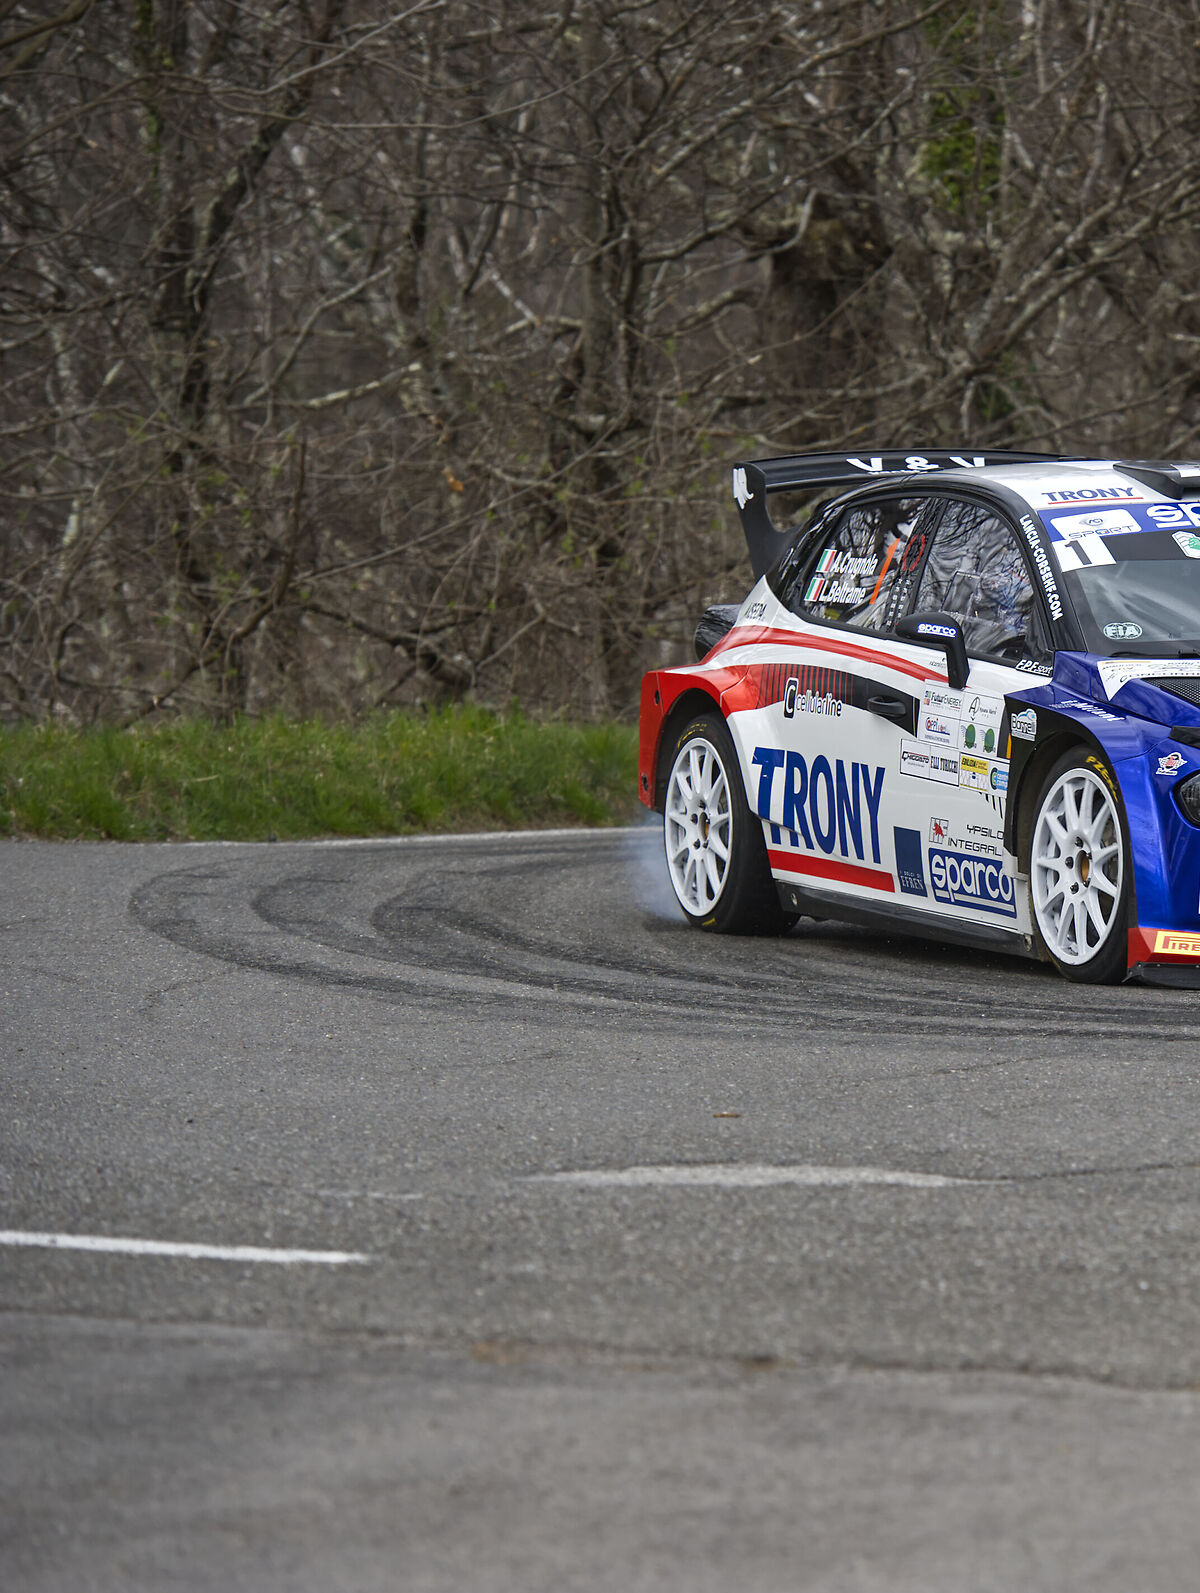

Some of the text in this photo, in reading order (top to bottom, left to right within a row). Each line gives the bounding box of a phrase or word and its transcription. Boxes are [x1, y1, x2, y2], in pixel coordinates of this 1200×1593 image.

[846, 456, 985, 472] V & V
[1041, 487, 1133, 502] TRONY
[1068, 525, 1134, 539] SPORT
[1064, 540, 1093, 566] 1
[918, 623, 957, 636] sparco
[1107, 625, 1137, 638] FIA
[751, 746, 886, 864] TRONY
[966, 824, 1004, 840] YPSILO
[947, 837, 1002, 857] INTEGRAL
[931, 854, 1013, 902] sparco
